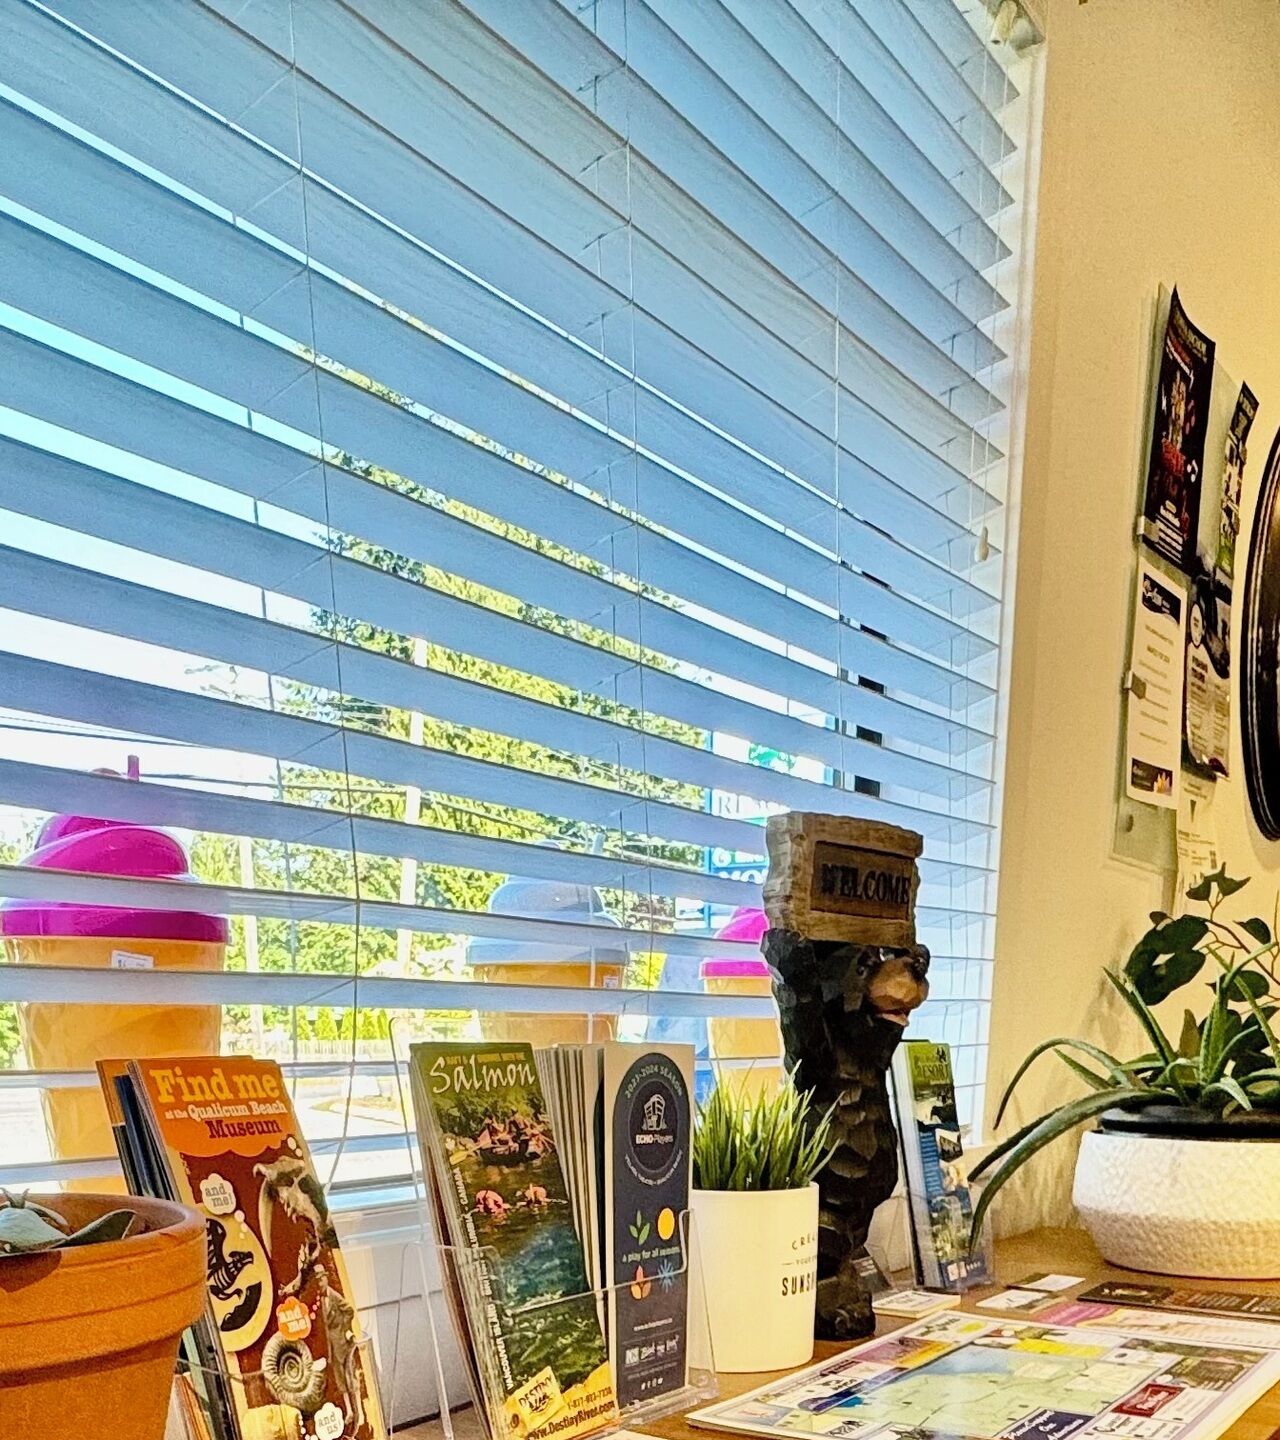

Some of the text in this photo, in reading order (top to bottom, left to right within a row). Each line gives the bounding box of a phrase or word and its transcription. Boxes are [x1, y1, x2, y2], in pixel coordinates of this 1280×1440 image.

[822, 863, 911, 904] WELCOME
[149, 1064, 282, 1103] Find me
[429, 1053, 536, 1094] Salmon
[187, 1101, 251, 1122] Qualicum
[249, 1099, 289, 1115] Beach
[204, 1118, 283, 1139] Museum
[204, 1182, 227, 1196] and
[212, 1193, 234, 1208] me!
[279, 1304, 302, 1323] and
[518, 1374, 552, 1409] DESTINY
[317, 1411, 336, 1428] and
